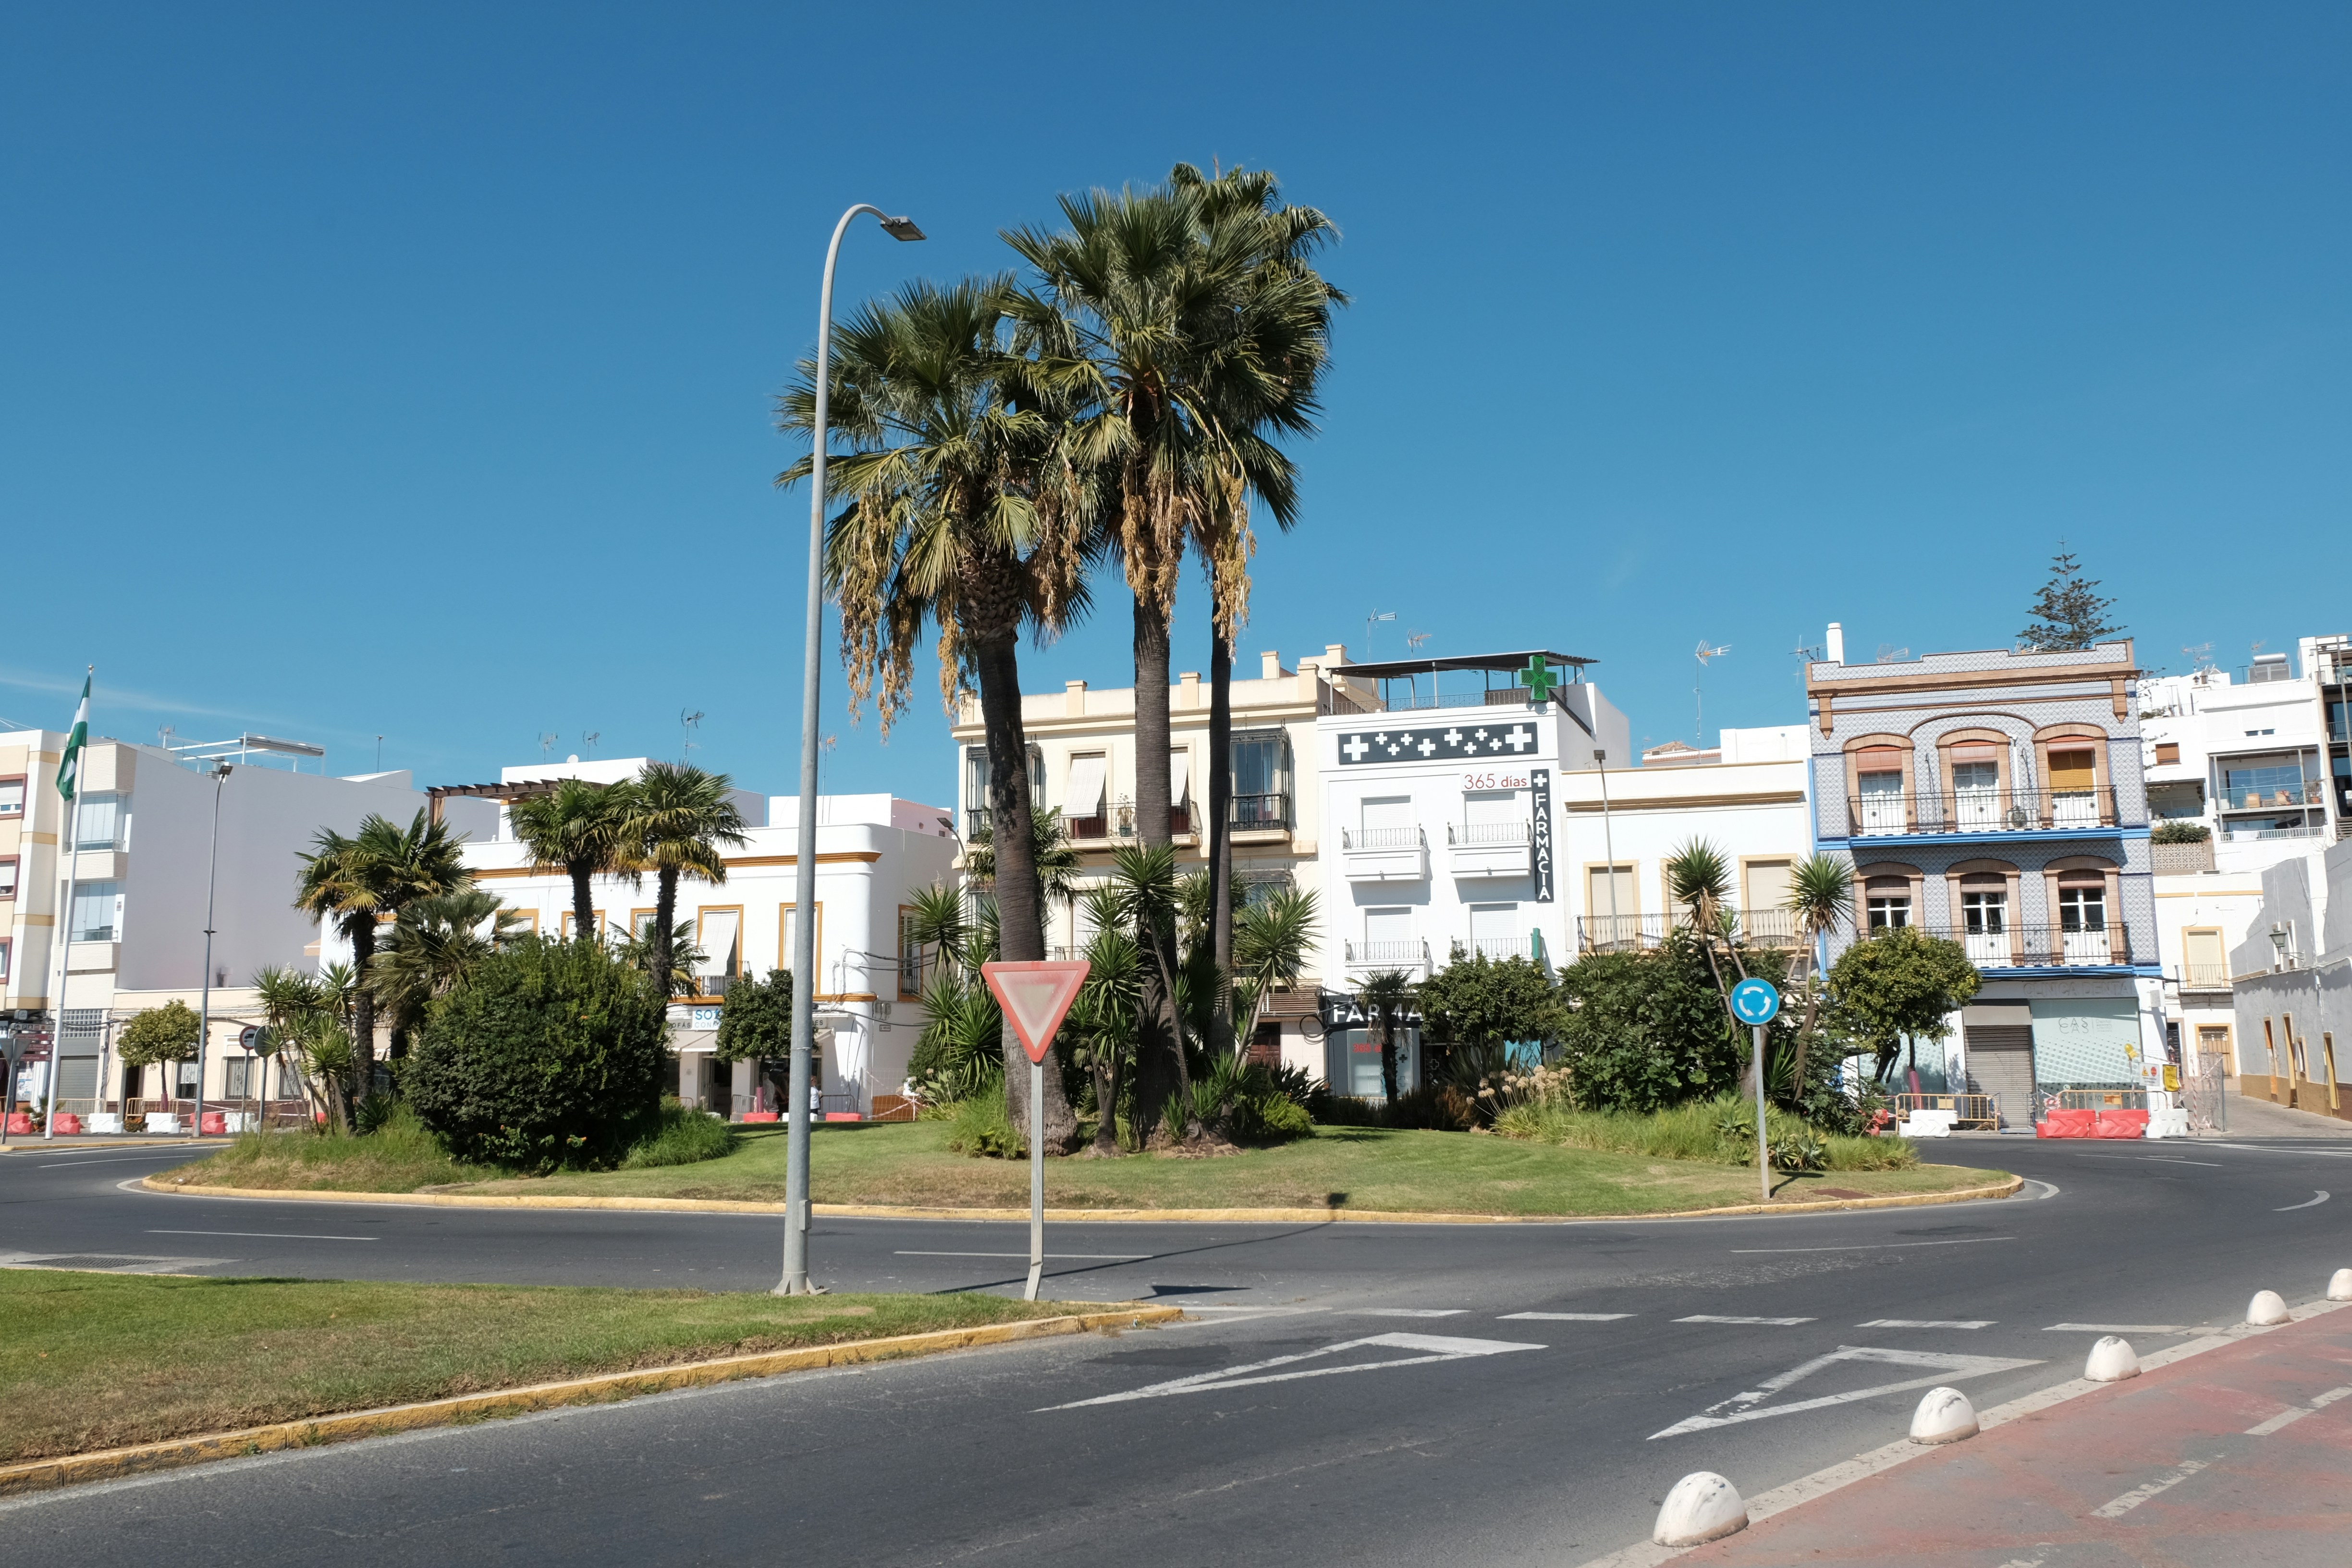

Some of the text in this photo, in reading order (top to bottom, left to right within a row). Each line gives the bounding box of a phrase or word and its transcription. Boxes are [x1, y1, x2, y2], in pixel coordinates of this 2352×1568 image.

[1464, 774, 1527, 789] 365 días
[1535, 793, 1551, 900] FARMACIA
[1334, 1004, 1424, 1022] FARMA
[1353, 1043, 1371, 1053] 365
